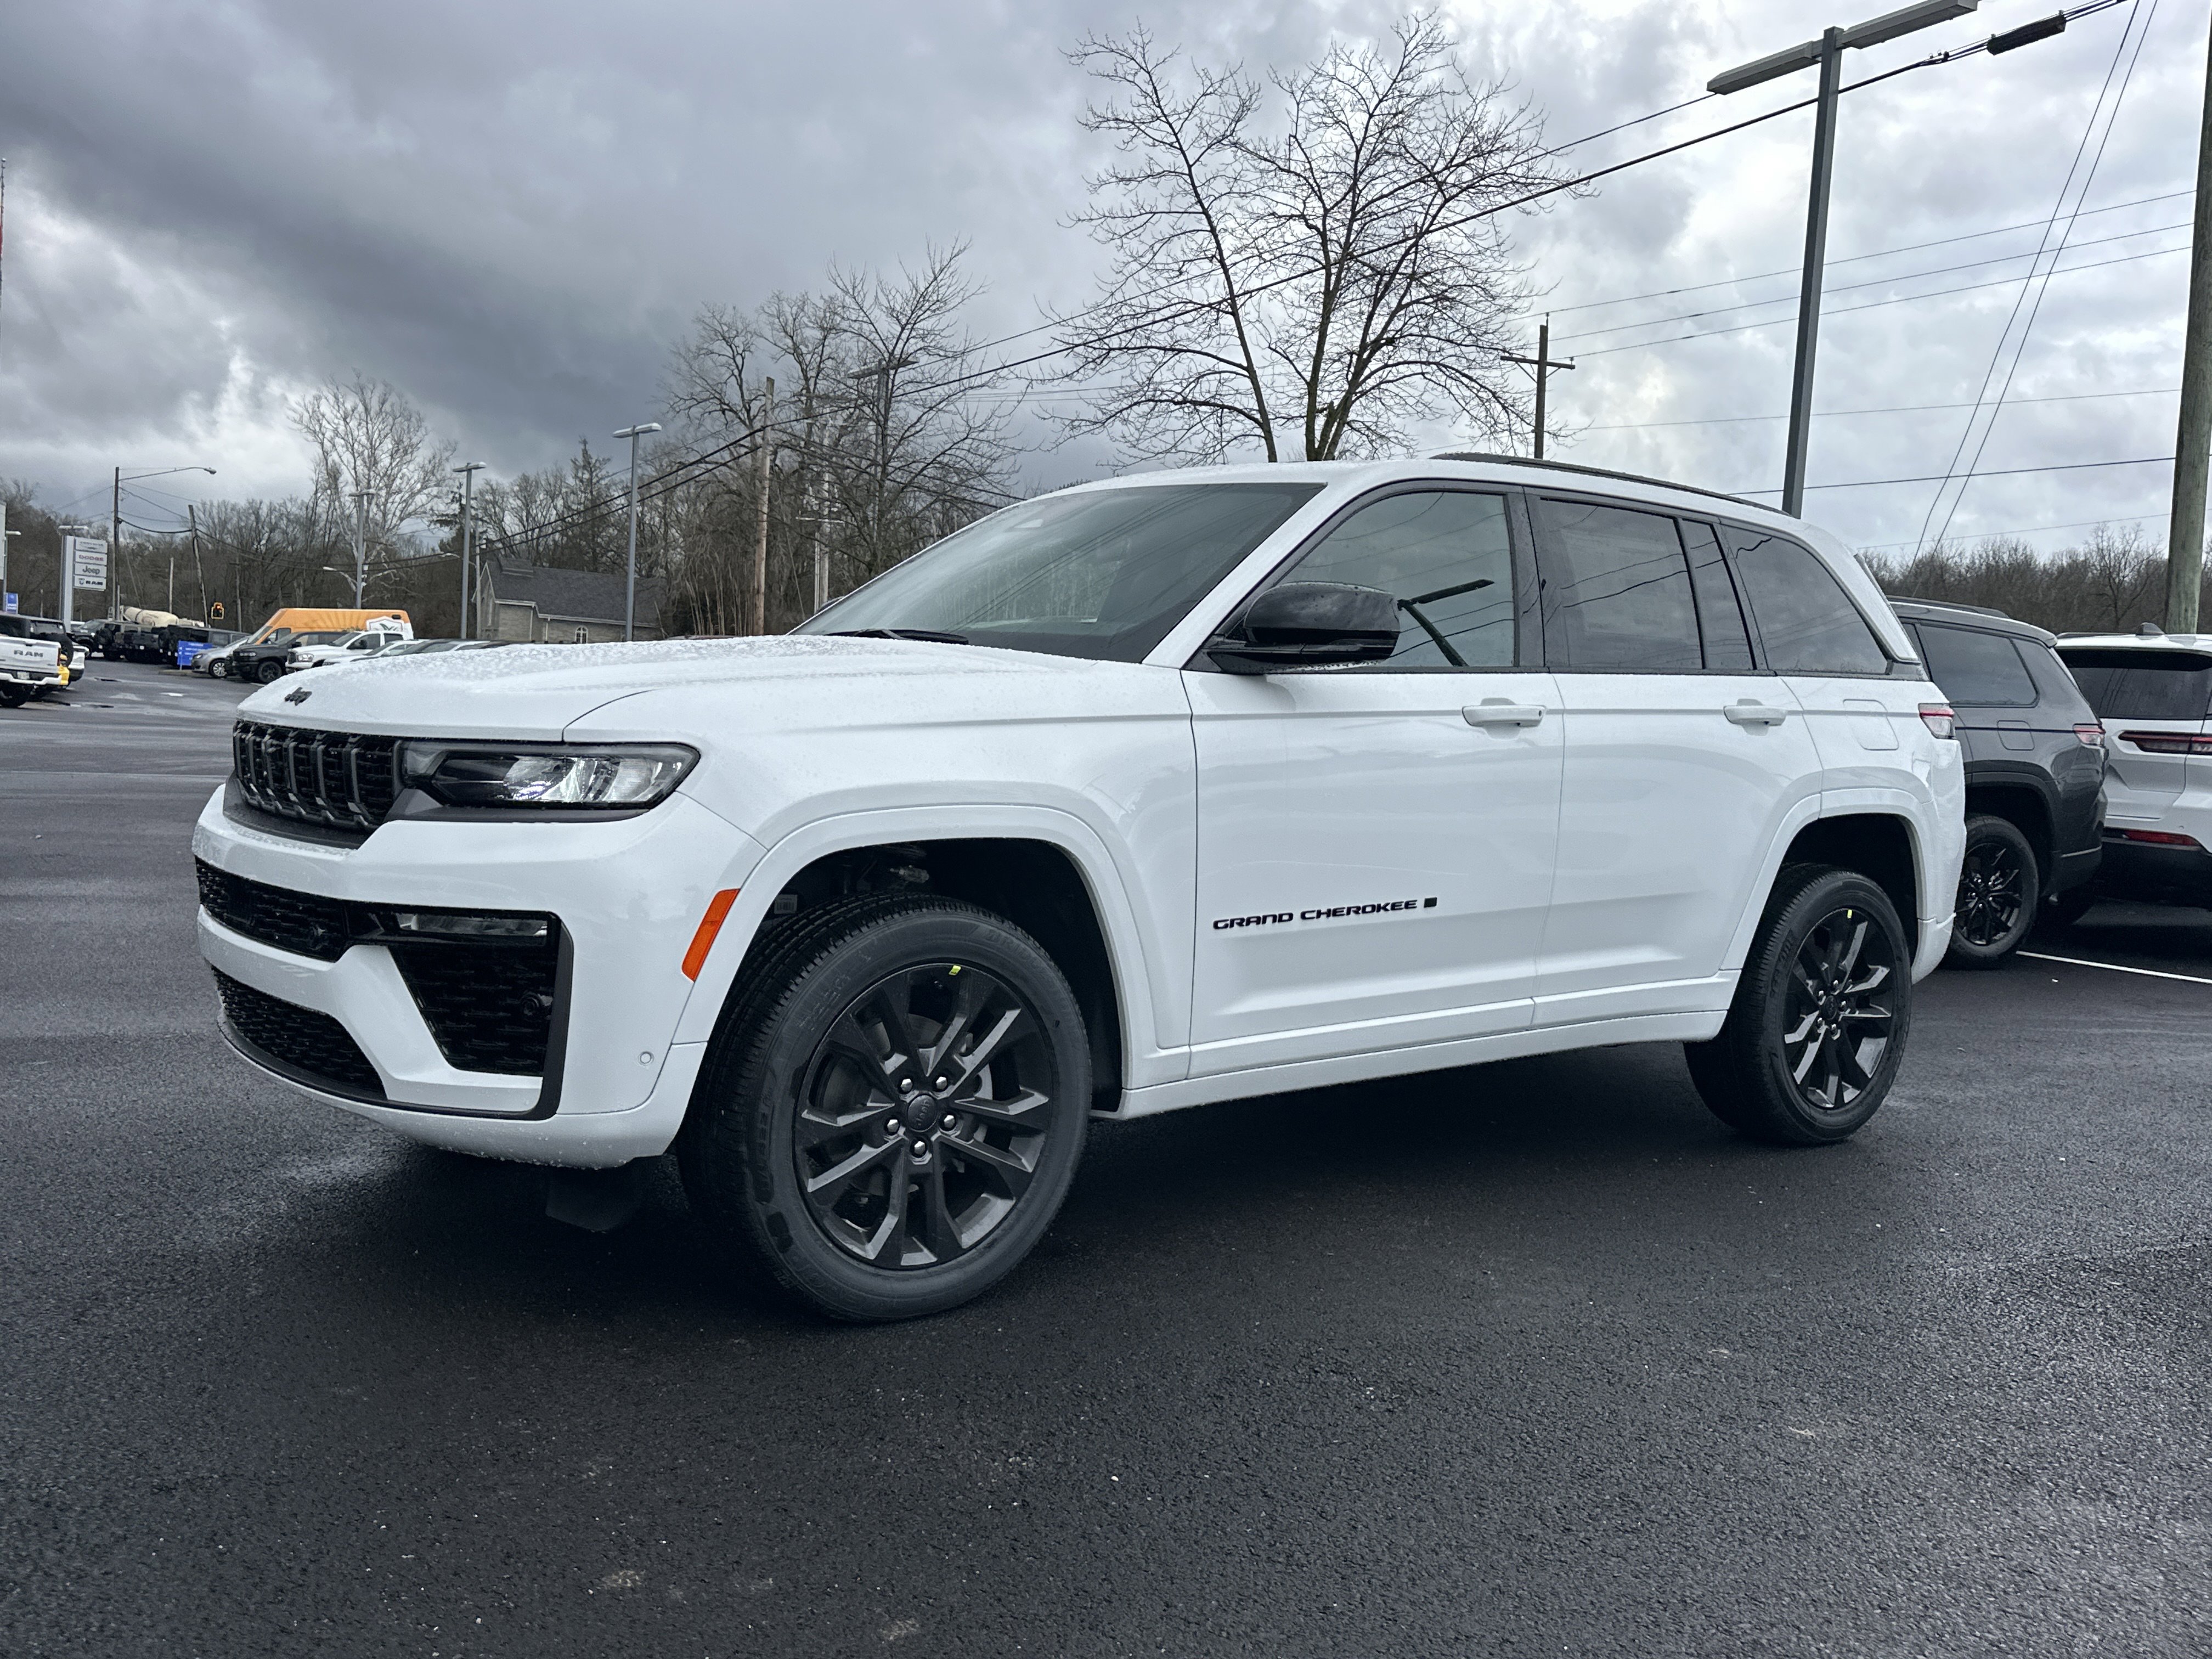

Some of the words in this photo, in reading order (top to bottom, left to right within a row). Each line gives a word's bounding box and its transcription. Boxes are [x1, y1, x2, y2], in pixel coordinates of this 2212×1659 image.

[82, 565, 100, 575] Jeep
[1212, 912, 1294, 929] GRAND
[1300, 899, 1418, 921] CHEROKEE
